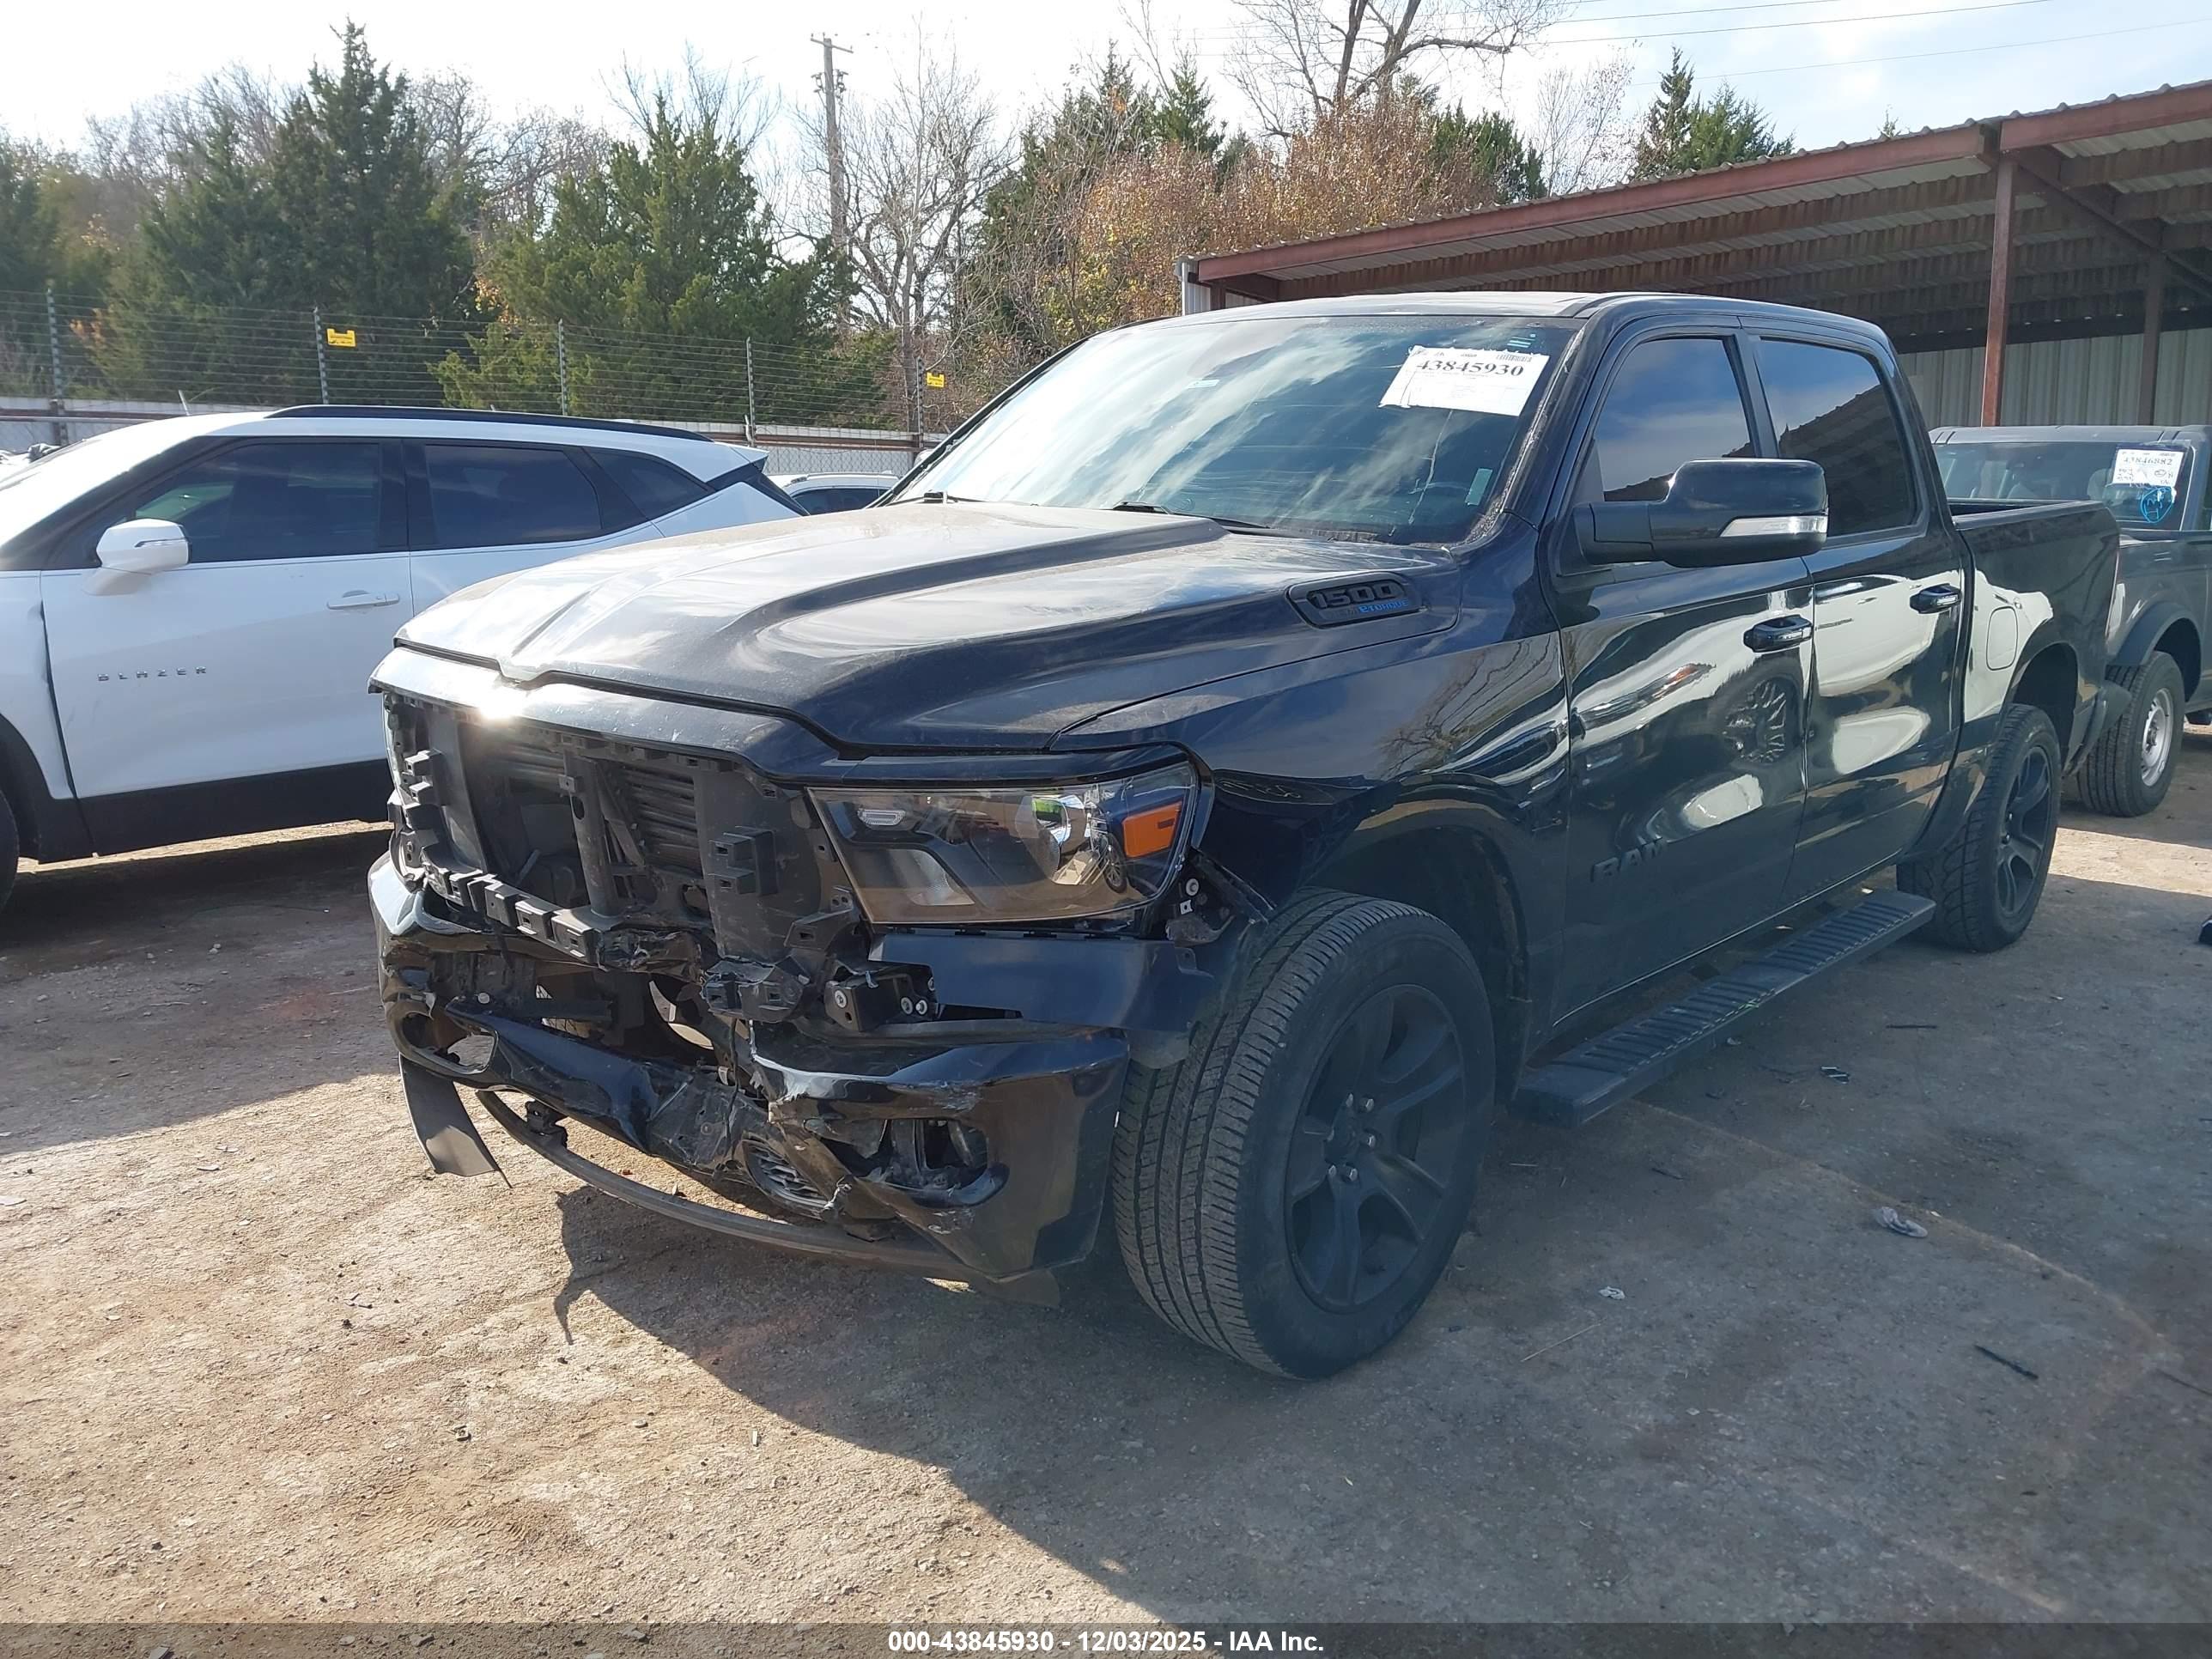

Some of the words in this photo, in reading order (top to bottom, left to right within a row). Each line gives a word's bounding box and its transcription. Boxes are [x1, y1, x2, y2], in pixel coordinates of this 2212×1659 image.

[1416, 359, 1524, 377] 43845930
[1310, 580, 1405, 609] 1500
[97, 665, 207, 682] BLAZER
[1589, 837, 1666, 883] RAM
